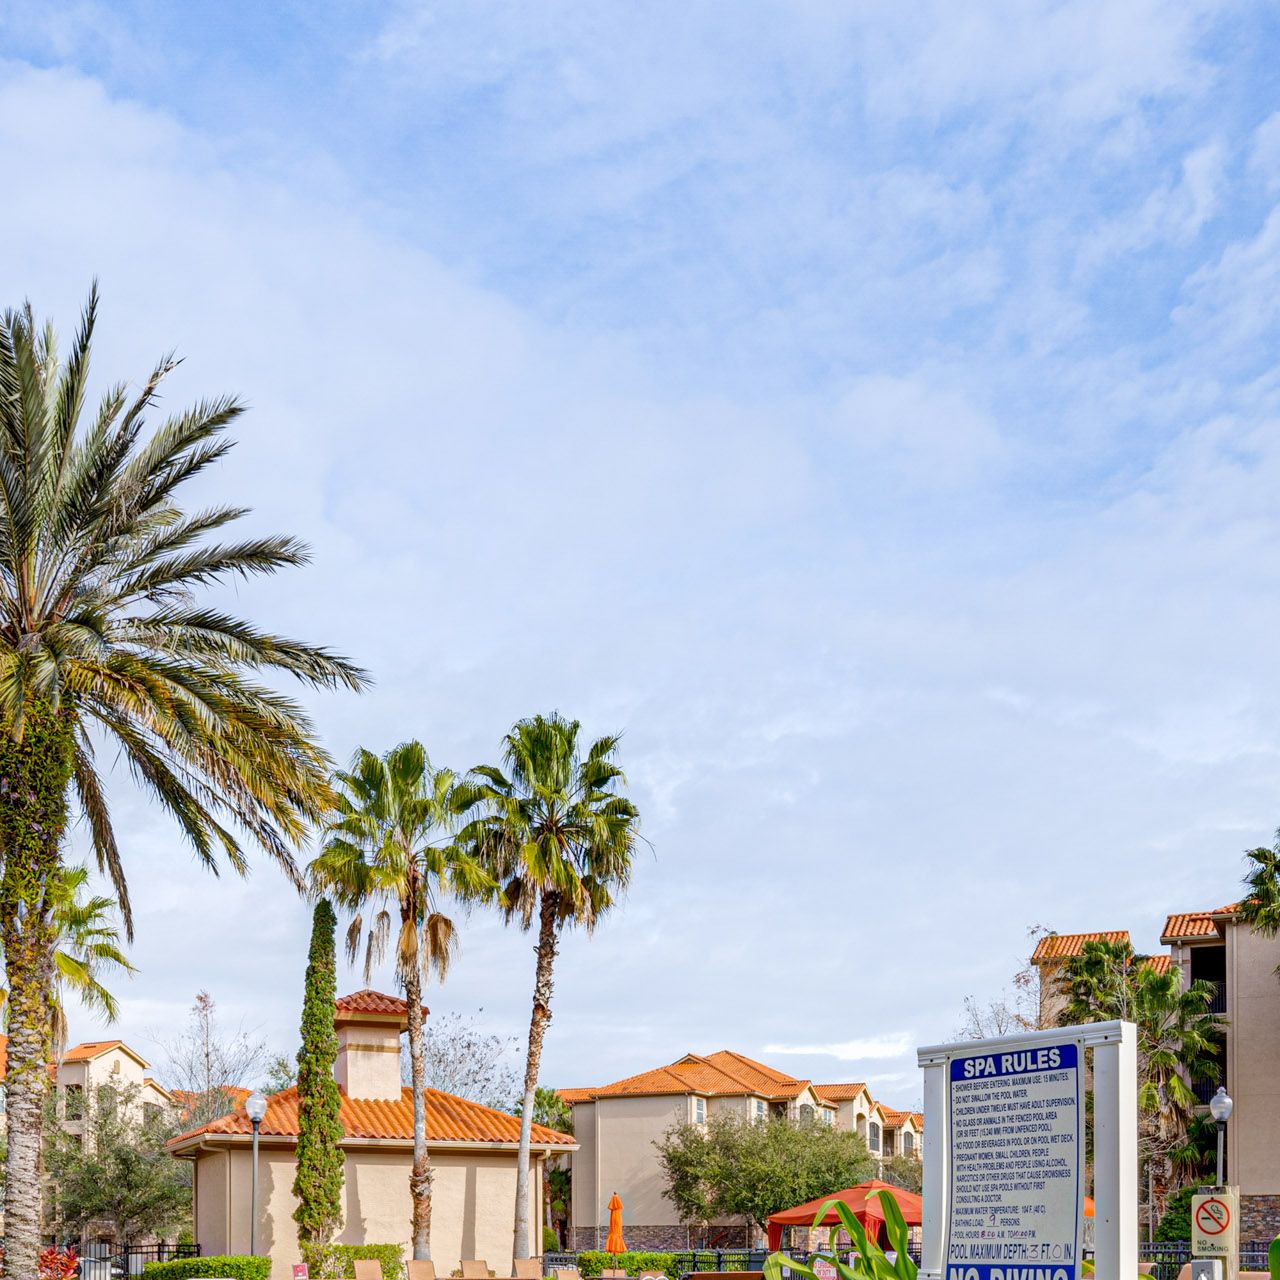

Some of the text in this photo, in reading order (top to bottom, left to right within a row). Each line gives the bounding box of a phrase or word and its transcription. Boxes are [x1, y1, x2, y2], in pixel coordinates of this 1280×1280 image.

[964, 1048, 1061, 1078] SPA RULES
[956, 1083, 972, 1092] SHOWER
[974, 1081, 989, 1090] BEFORE
[1012, 1076, 1031, 1087] MAXIMUM
[1043, 1074, 1048, 1083] 15
[956, 1089, 1028, 1104] DO NOT SWALLOW THE POOL WATER.
[956, 1097, 1076, 1116] CHILDREN UNDER TWELVE MUST HAVE ADULT SUPERVISION.
[956, 1119, 962, 1127] NO
[963, 1118, 976, 1127] GLASS
[977, 1118, 983, 1126] OR
[983, 1116, 1001, 1125] ANIMALS
[1002, 1116, 1006, 1124] IN
[1015, 1113, 1032, 1123] FENCED
[1033, 1112, 1044, 1121] POOL
[1046, 1111, 1057, 1120] AREA
[969, 1128, 979, 1138] FEET
[1003, 1126, 1015, 1136] FROM
[1015, 1124, 1037, 1135] UNFENCED
[957, 1142, 962, 1150] NO
[963, 1141, 974, 1149] FOOD
[975, 1141, 981, 1149] OR
[982, 1139, 1006, 1148] BEVERAGES
[1007, 1138, 1011, 1147] IN
[1012, 1138, 1023, 1146] POOL
[1024, 1137, 1030, 1146] OR
[1031, 1136, 1037, 1145] ON
[1038, 1136, 1050, 1145] POOL
[1051, 1135, 1060, 1144] WET
[957, 1152, 978, 1161] PREGNANT
[995, 1151, 1009, 1159] SMALL
[1032, 1148, 1049, 1157] PEOPLE
[957, 1164, 966, 1172] WITH
[967, 1163, 982, 1172] HEALTH
[983, 1162, 1005, 1171] PROBLEMS
[1005, 1161, 1014, 1170] AND
[1015, 1160, 1031, 1169] PEOPLE
[1032, 1159, 1045, 1169] USING
[957, 1169, 1071, 1182] NARCOTICS OR OTHER DRUGS THAT CAUSE DROWSINESS
[956, 1184, 972, 1193] SHOULD
[973, 1184, 981, 1192] NOT
[982, 1183, 990, 1192] USE
[999, 1183, 1013, 1191] POOLS
[1014, 1182, 1033, 1191] WITHOUT
[1034, 1181, 1045, 1190] FIRST
[956, 1195, 980, 1204] CONSULTING
[981, 1195, 984, 1203] A
[955, 1207, 974, 1215] MAXIMUM
[975, 1207, 988, 1215] WATER
[955, 1219, 972, 1227] BATHING
[989, 1214, 996, 1226] 9
[954, 1231, 965, 1239] POOL
[1008, 1230, 1013, 1238] TO
[950, 1245, 968, 1259] POOL
[970, 1244, 1002, 1259] MAXIMUM
[1004, 1244, 1028, 1259] DEPTH:
[1041, 1244, 1051, 1259] FT.
